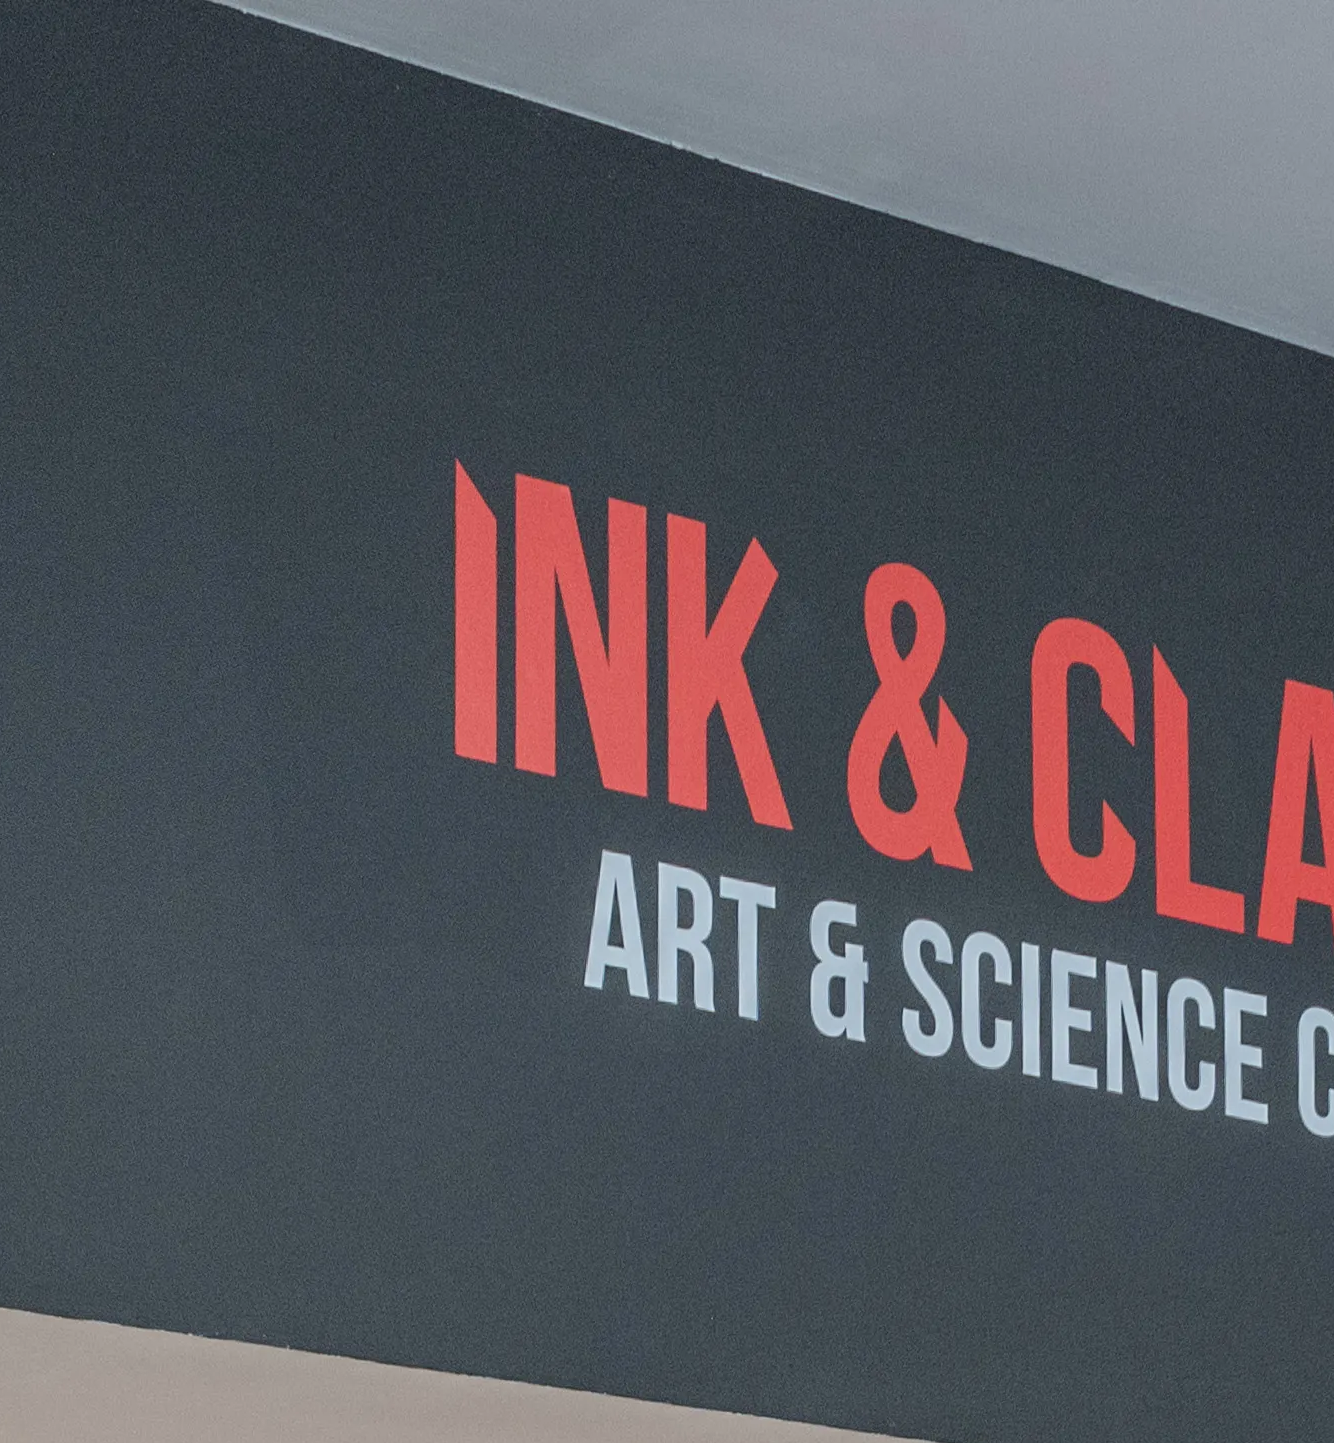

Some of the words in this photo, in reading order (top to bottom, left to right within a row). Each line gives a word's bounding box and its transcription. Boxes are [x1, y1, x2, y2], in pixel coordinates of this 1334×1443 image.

[454, 459, 793, 830] INK
[847, 563, 973, 872] &
[583, 848, 777, 1022] ART
[810, 898, 869, 1043] &
[902, 917, 1270, 1125] SCIENCE
